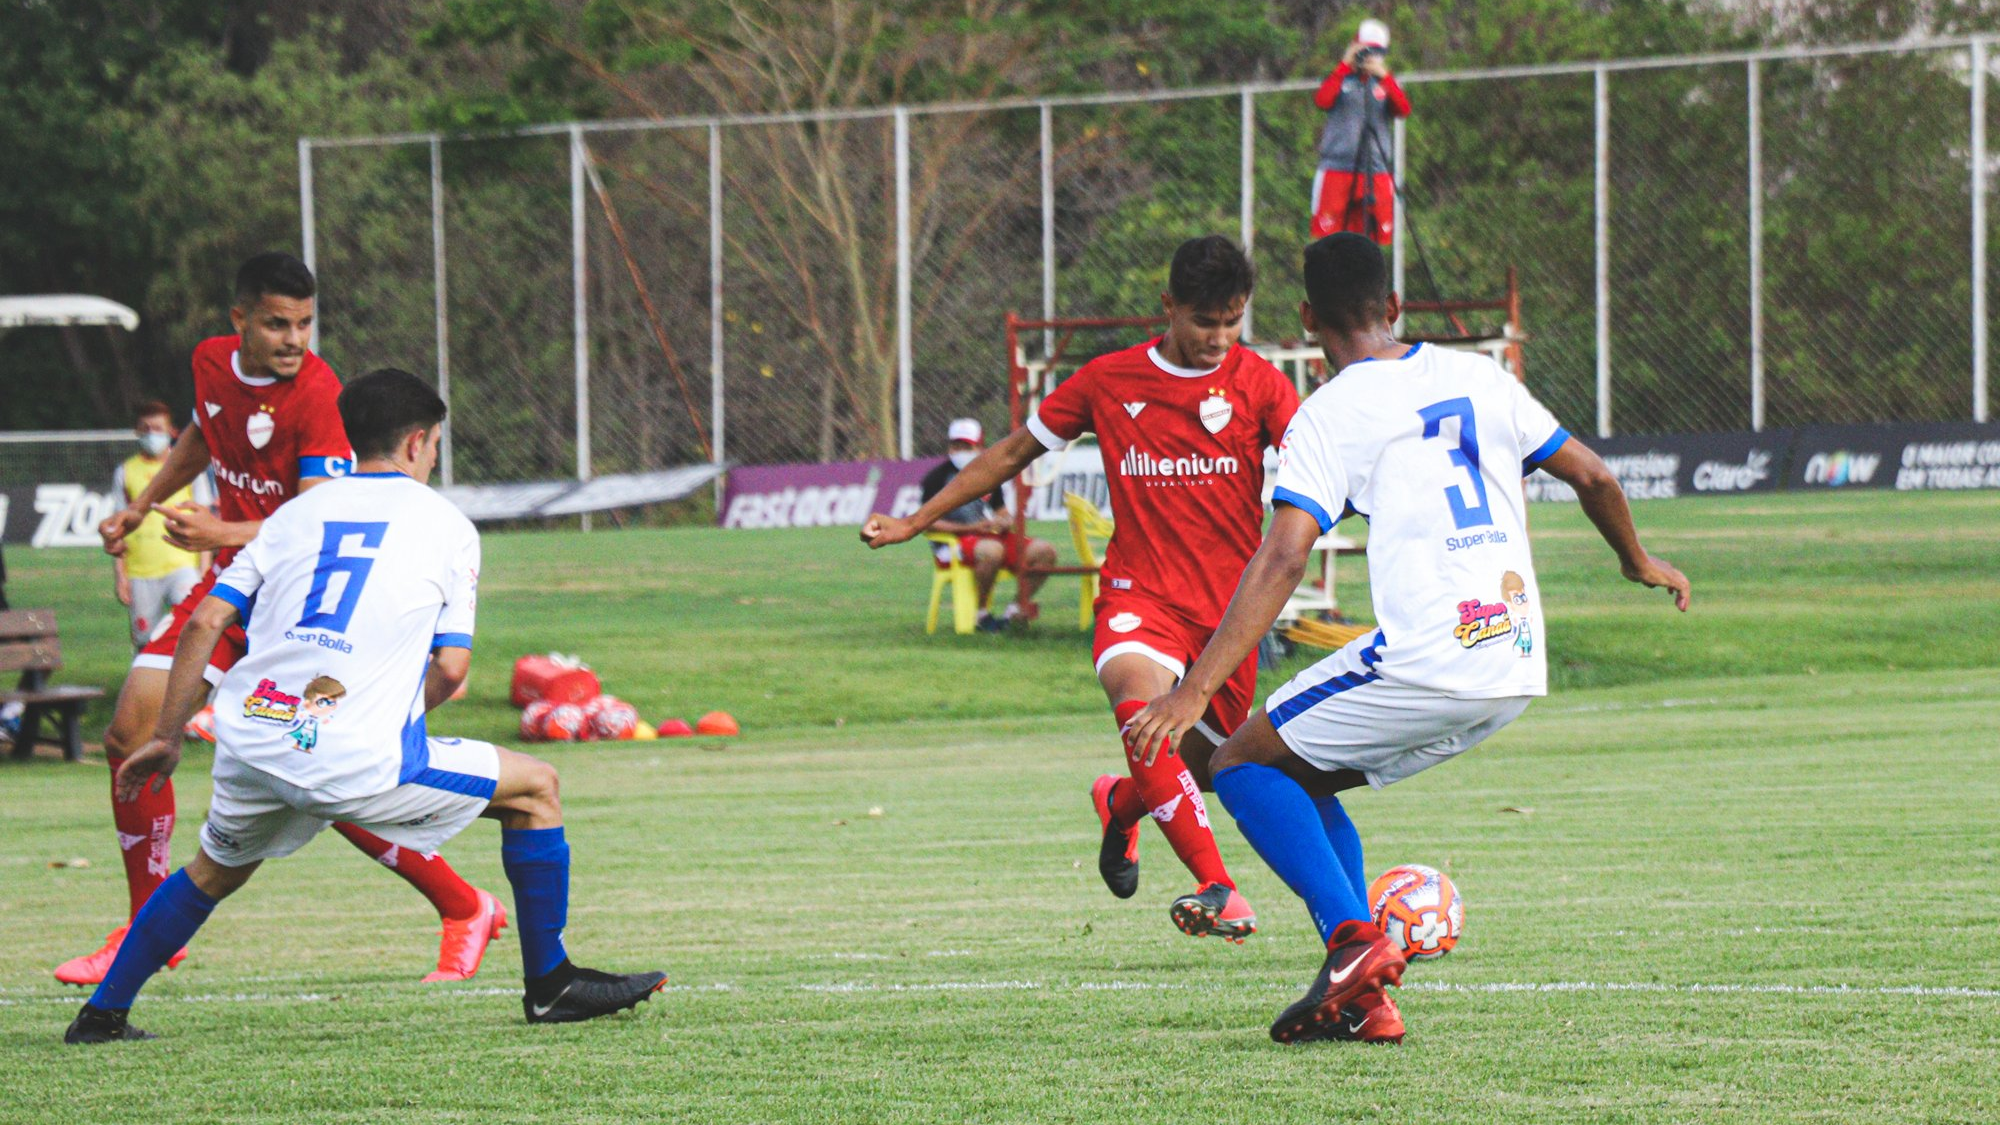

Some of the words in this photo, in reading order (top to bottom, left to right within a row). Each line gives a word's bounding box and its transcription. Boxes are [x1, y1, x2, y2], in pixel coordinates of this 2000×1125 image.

[324, 456, 346, 478] C
[1416, 397, 1494, 530] 3
[1446, 532, 1487, 551] Super
[296, 521, 390, 634] 6
[1457, 599, 1508, 627] Super
[317, 633, 354, 655] Bolla
